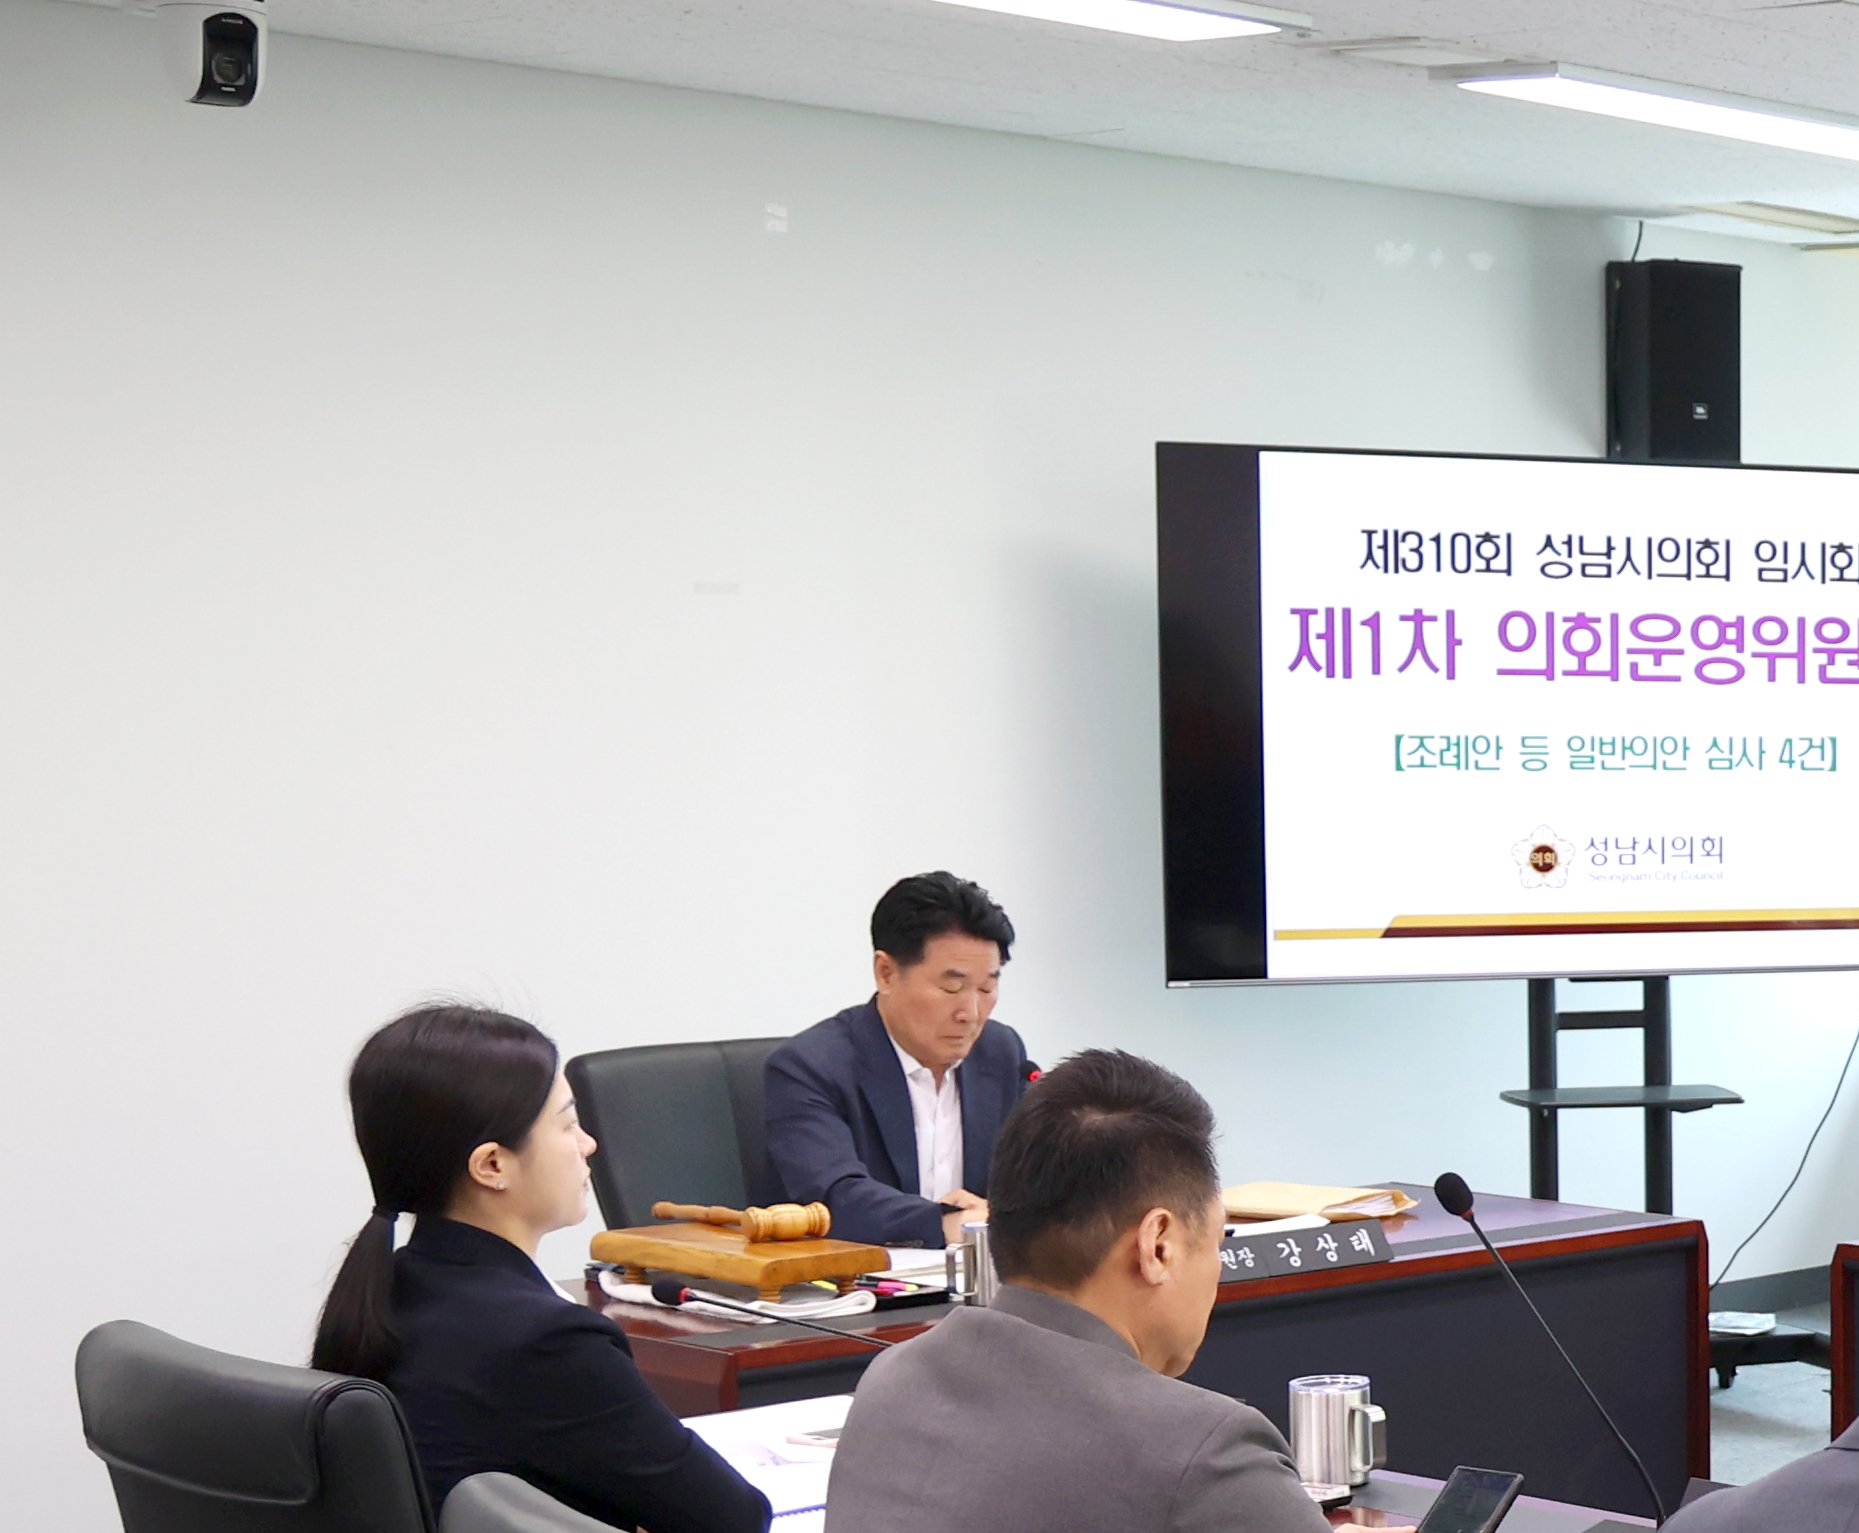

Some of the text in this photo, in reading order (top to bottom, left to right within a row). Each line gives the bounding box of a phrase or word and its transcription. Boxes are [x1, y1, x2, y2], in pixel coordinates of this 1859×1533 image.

[1360, 529, 1512, 576] 제310회
[1536, 534, 1730, 582] 성남시의회
[1288, 607, 1462, 680] 제1차
[1520, 736, 1549, 771] 등
[1567, 736, 1690, 770] 일반의안
[1706, 737, 1766, 770] 심사
[1584, 836, 1724, 866] 성남시의회
[1589, 871, 1723, 882] Seongnam City Council
